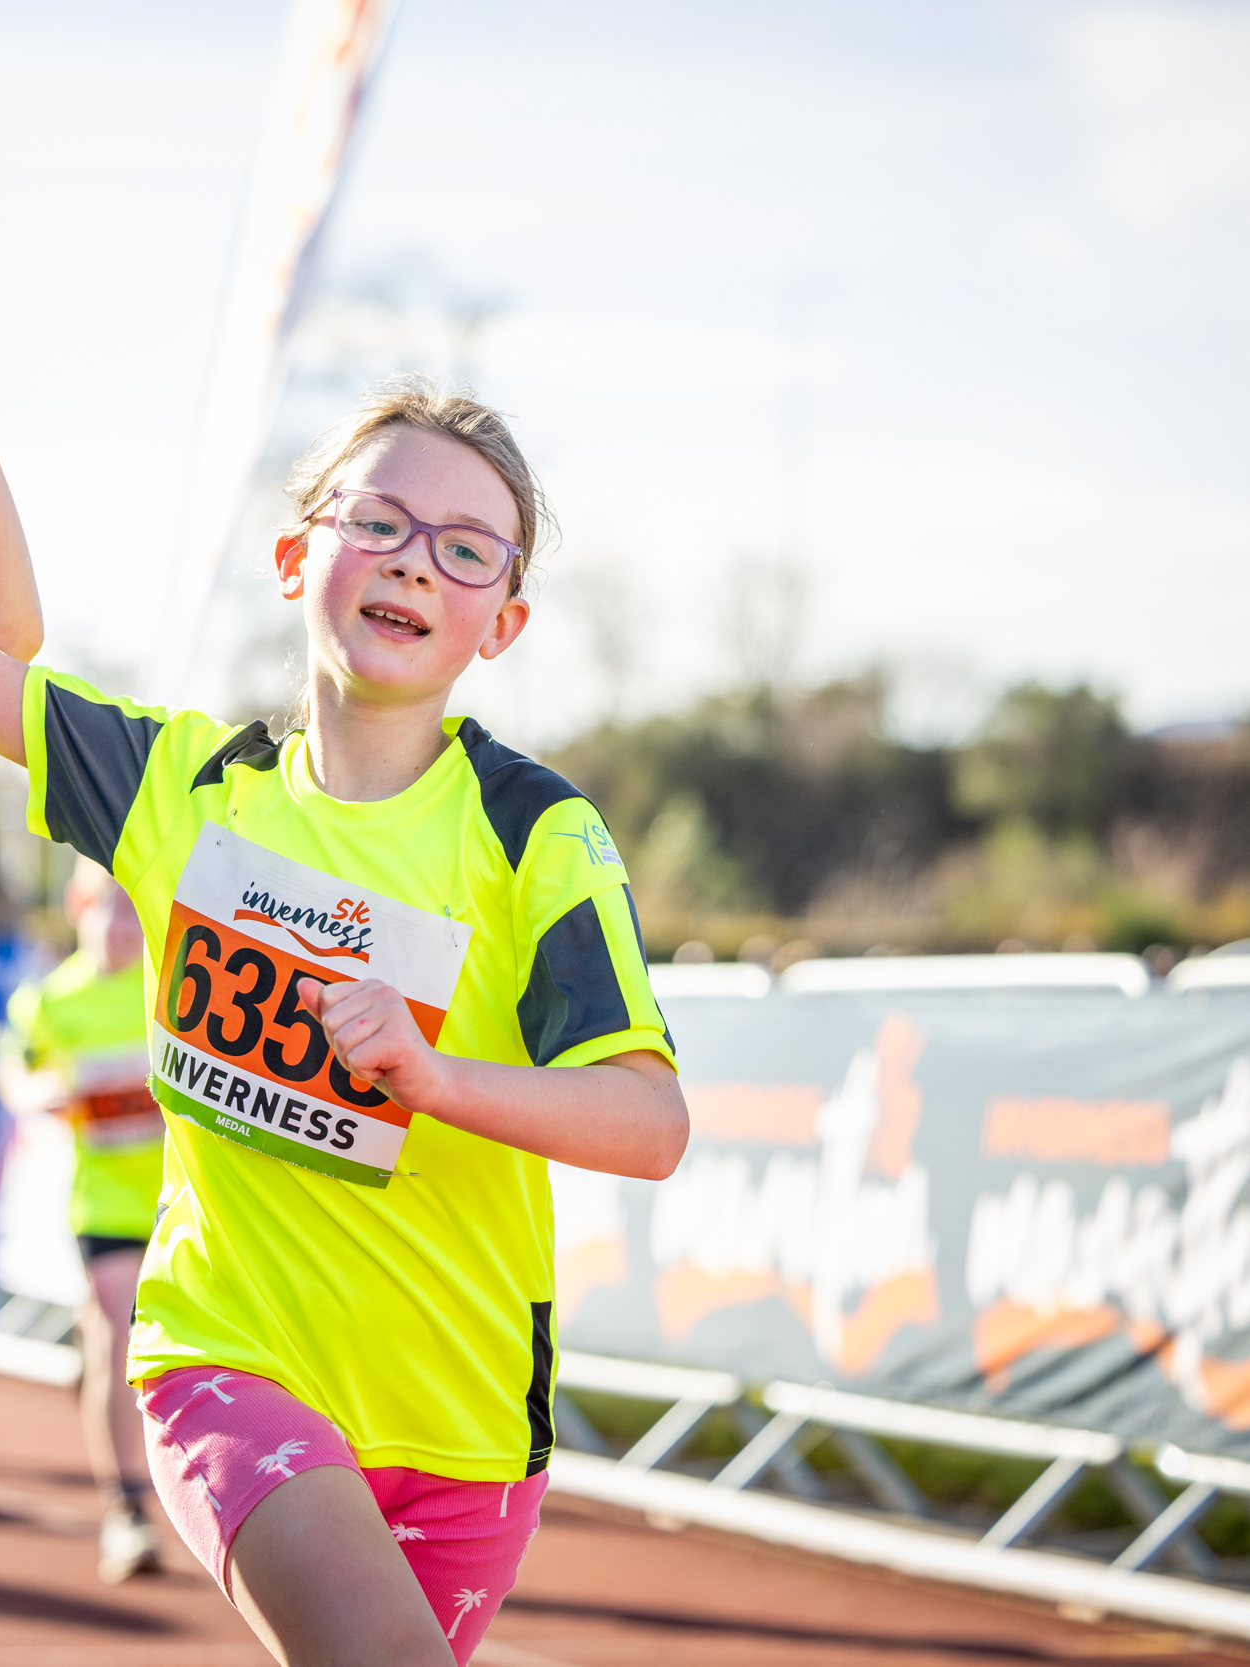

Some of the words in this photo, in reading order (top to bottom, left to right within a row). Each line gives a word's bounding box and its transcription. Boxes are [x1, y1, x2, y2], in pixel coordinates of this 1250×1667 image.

[242, 881, 374, 955] inverness
[161, 1041, 359, 1150] INVERNESS
[215, 1114, 251, 1137] MEDAL
